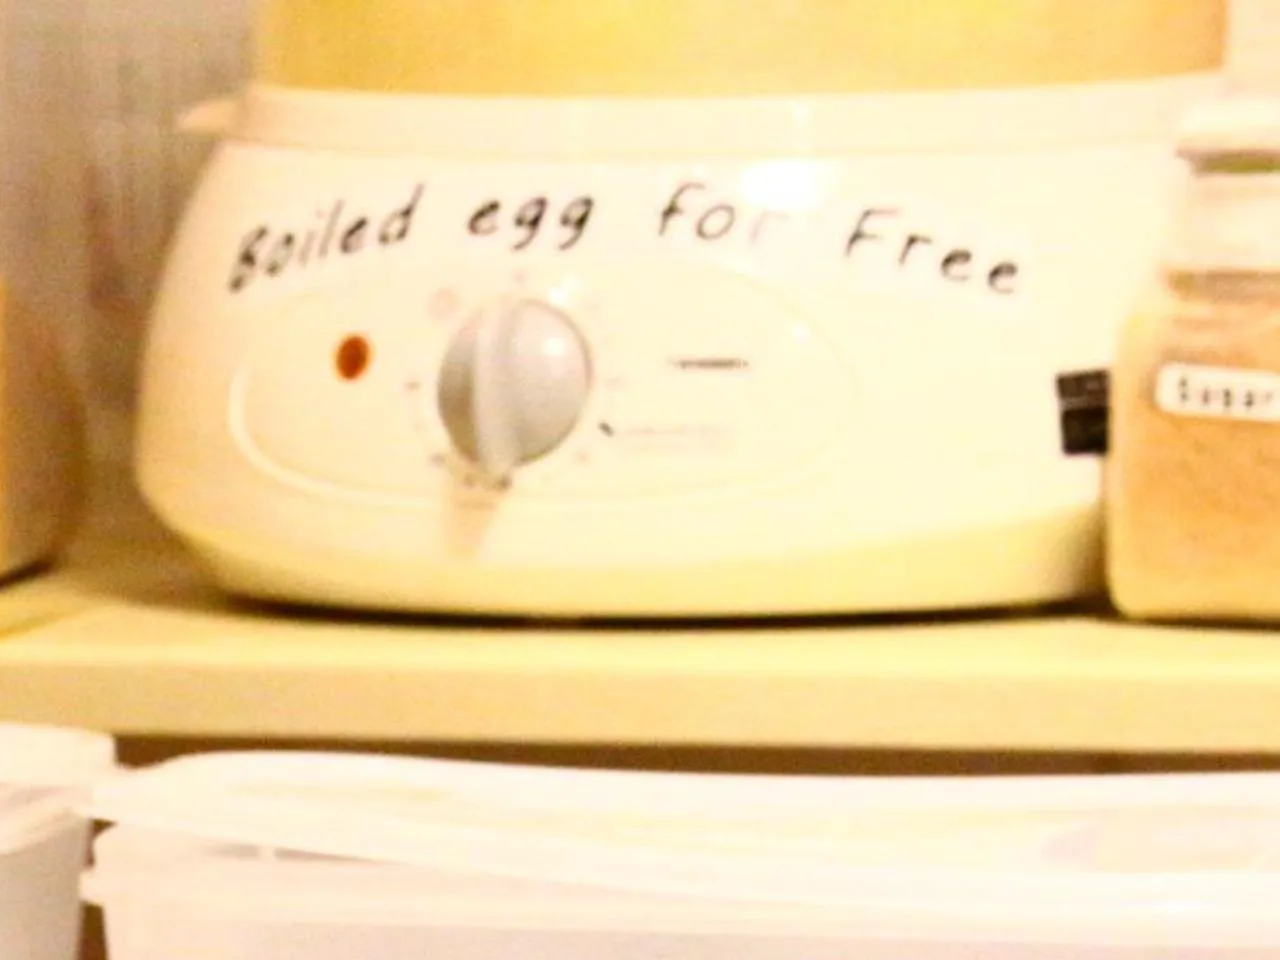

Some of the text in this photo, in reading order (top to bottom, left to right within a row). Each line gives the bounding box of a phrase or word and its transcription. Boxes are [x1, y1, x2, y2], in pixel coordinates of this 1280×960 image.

[227, 179, 1021, 295] Boiled egg for Free
